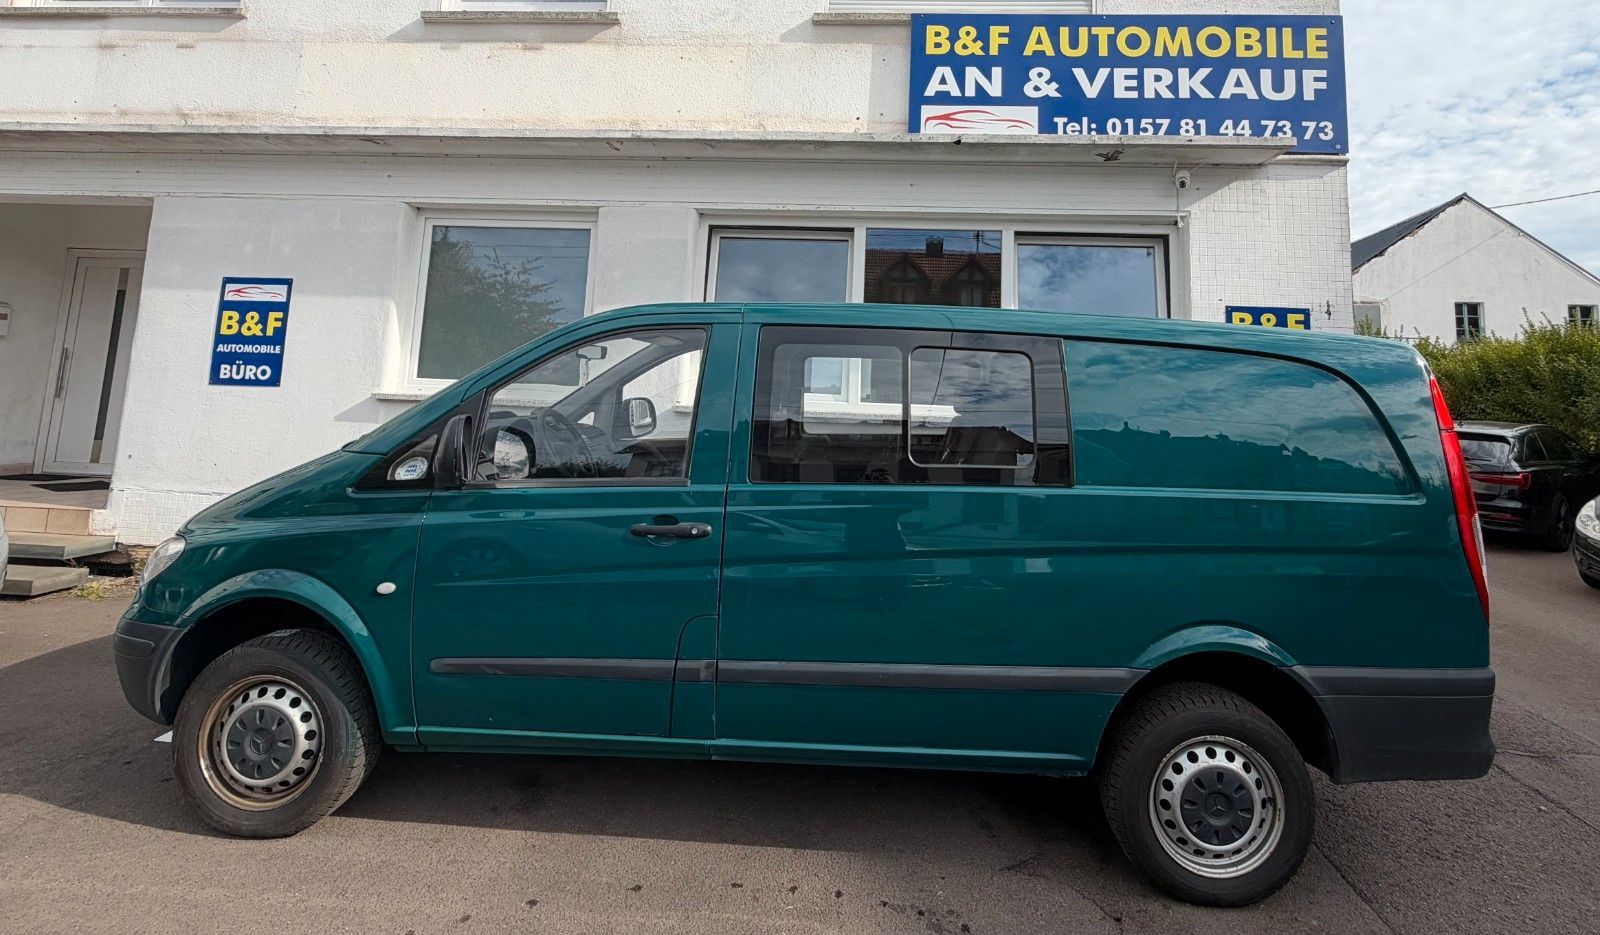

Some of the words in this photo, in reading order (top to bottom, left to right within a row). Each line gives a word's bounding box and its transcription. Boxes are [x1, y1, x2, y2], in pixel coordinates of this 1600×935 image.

[925, 25, 1010, 56] B&F
[1022, 26, 1329, 59] AUTOMOBILE
[923, 66, 1003, 97] AN
[1023, 67, 1063, 98] &
[1071, 67, 1328, 101] VERKAUF
[1053, 117, 1097, 135] Tel:
[1106, 118, 1171, 136] 0157
[1179, 119, 1207, 136] 81
[1219, 119, 1252, 137] 44
[1260, 120, 1293, 138] 73
[1301, 121, 1334, 141] 73
[220, 311, 283, 336] B&F
[217, 344, 281, 354] AUTOMOBILE
[219, 360, 272, 380] BÜRO
